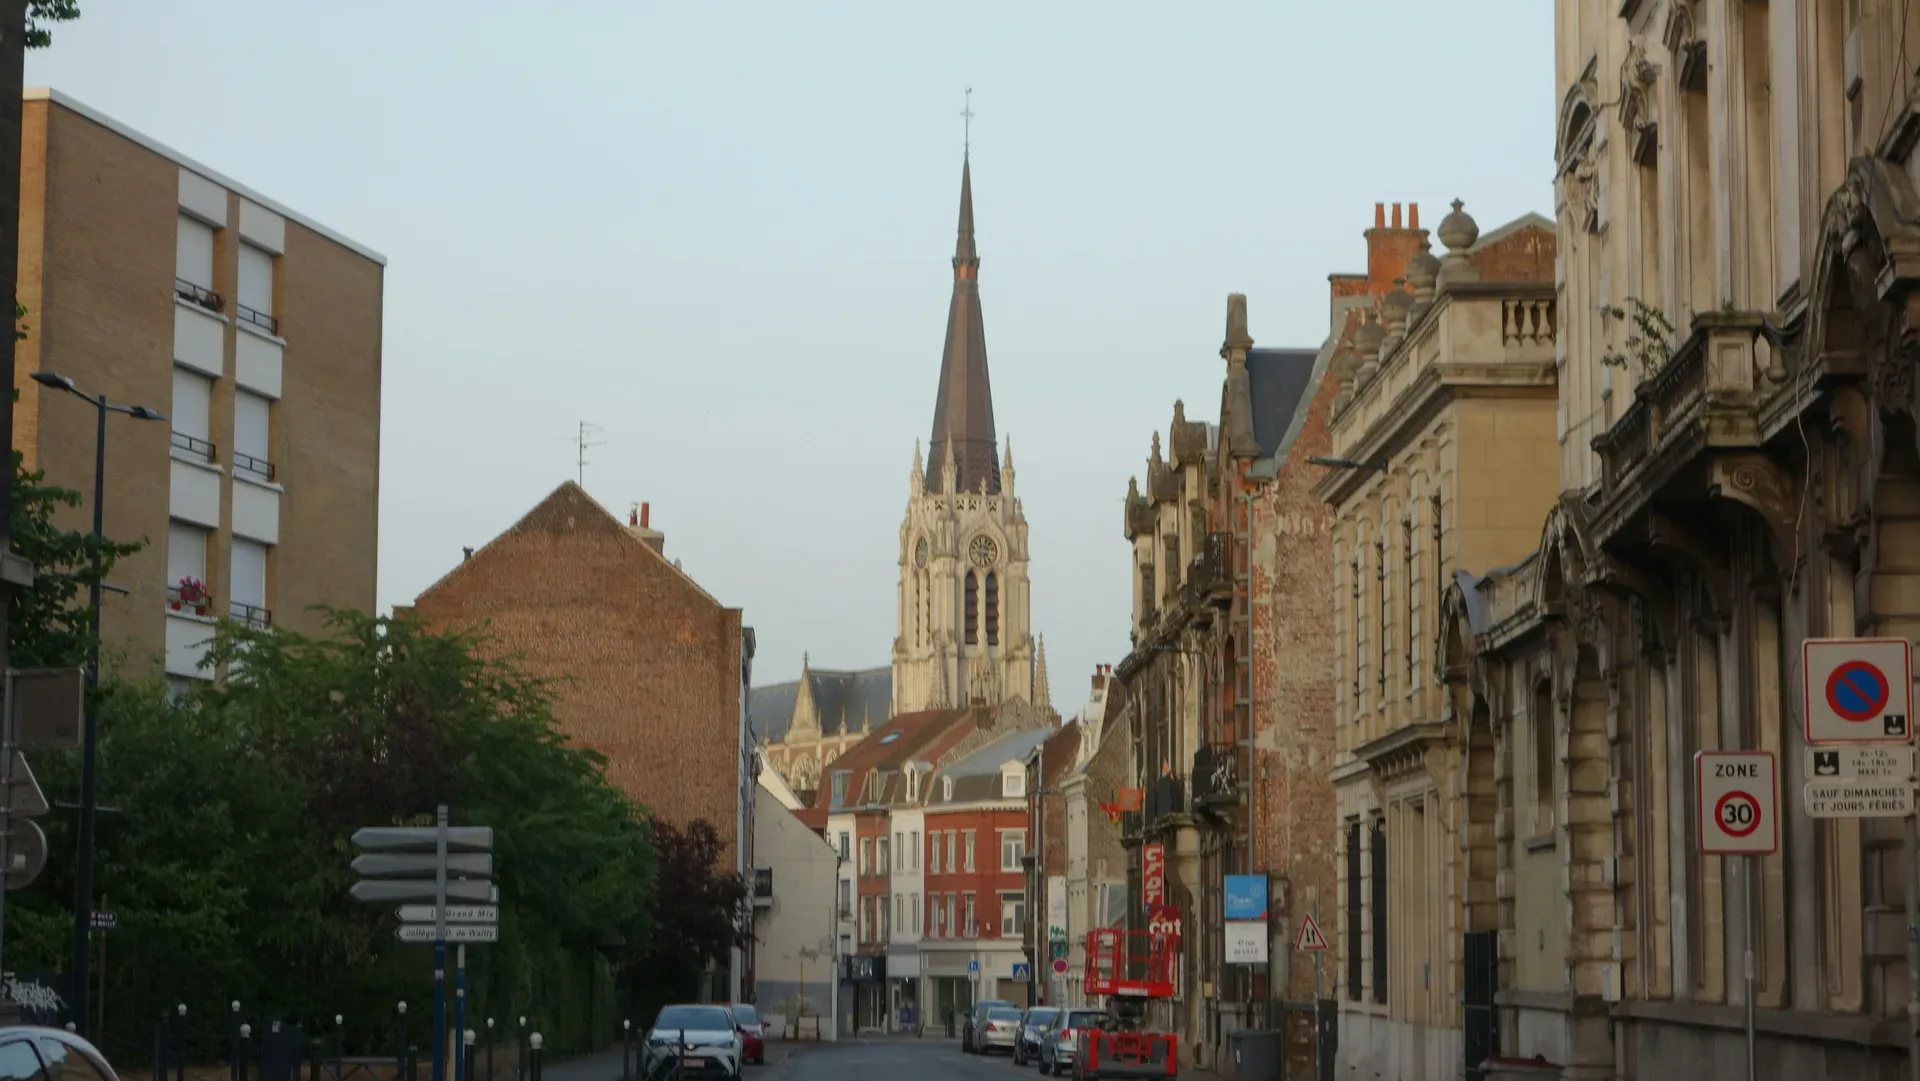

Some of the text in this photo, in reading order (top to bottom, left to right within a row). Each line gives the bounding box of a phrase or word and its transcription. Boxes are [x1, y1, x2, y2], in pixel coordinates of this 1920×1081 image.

[1715, 763, 1758, 777] ZONE
[1857, 768, 1879, 776] MAXI
[1812, 787, 1905, 799] SAUF DIMANCHES
[1813, 799, 1905, 813] ET JOURS FÉRIÉS
[1723, 803, 1753, 825] 30
[1145, 847, 1161, 904] CFDT
[445, 909, 473, 918] Grand
[477, 909, 494, 918] Mix
